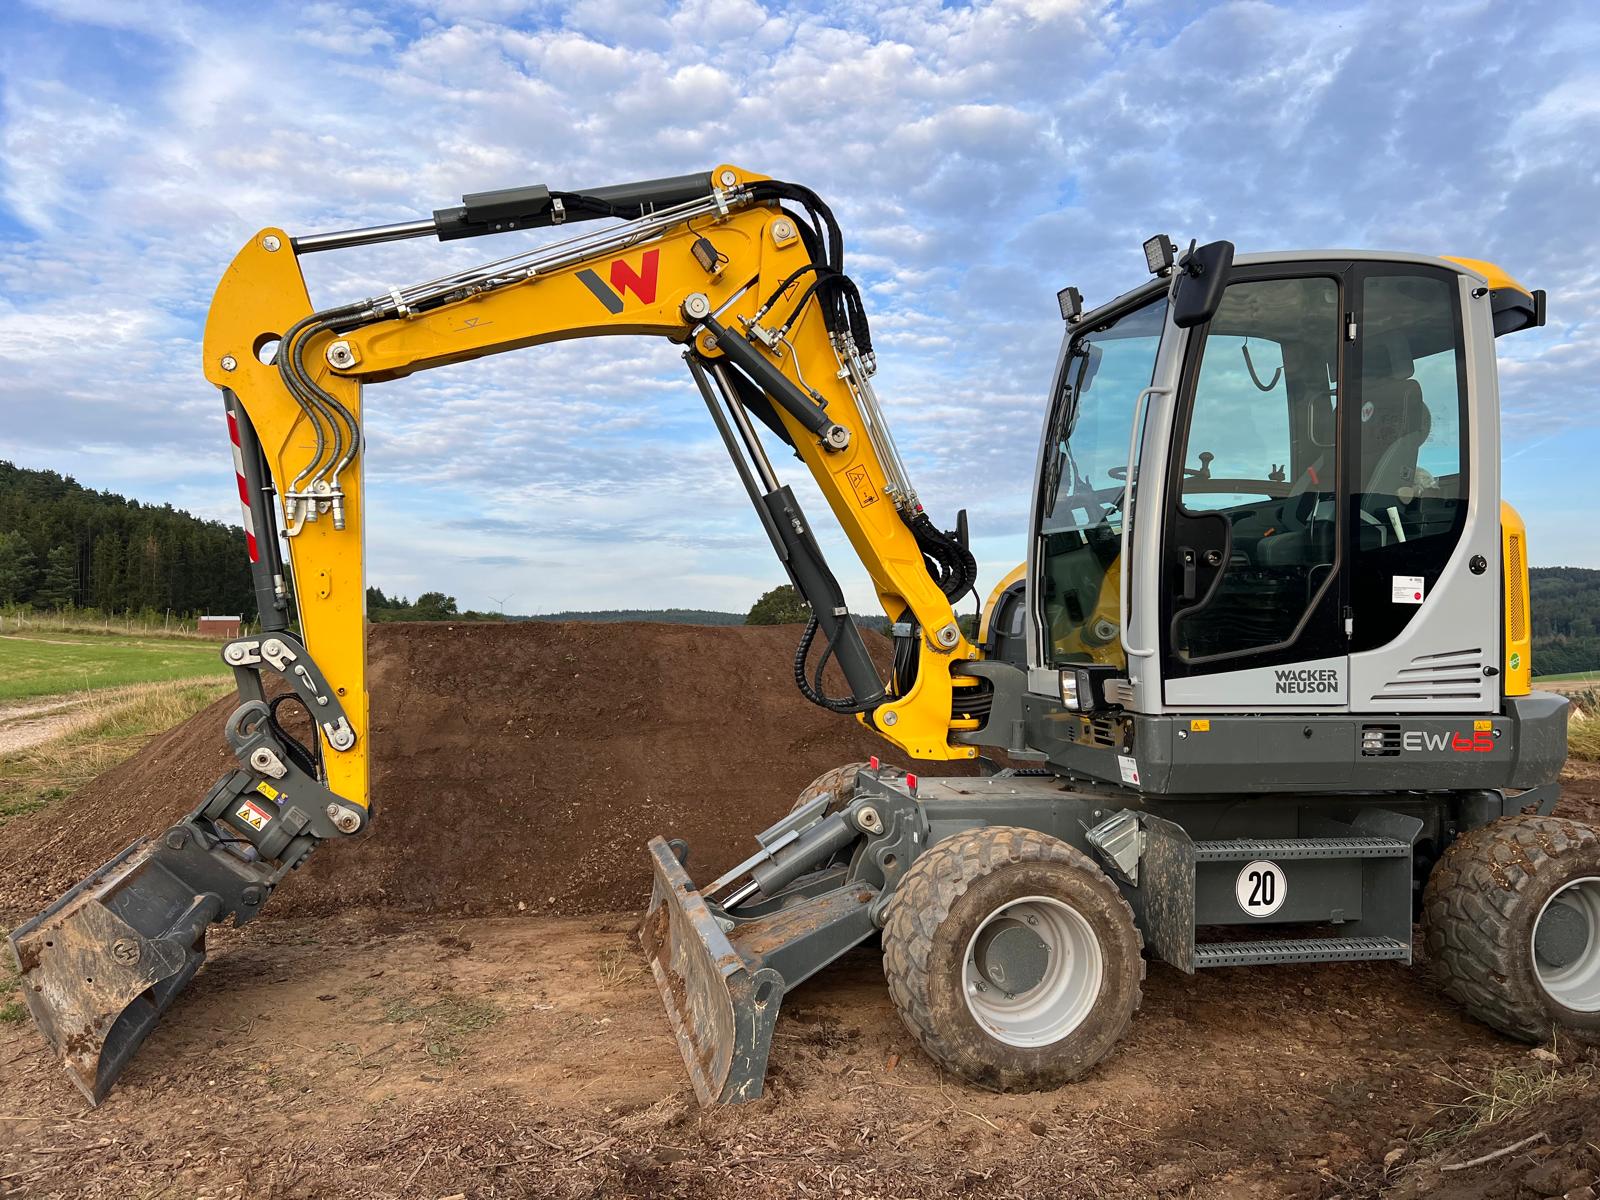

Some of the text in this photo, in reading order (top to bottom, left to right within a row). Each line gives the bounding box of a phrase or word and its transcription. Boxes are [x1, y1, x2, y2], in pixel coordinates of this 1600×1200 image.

[1274, 669, 1338, 682] WACKER
[1275, 681, 1339, 694] NEUSON
[1402, 730, 1495, 753] EW65
[1248, 870, 1275, 906] 20
